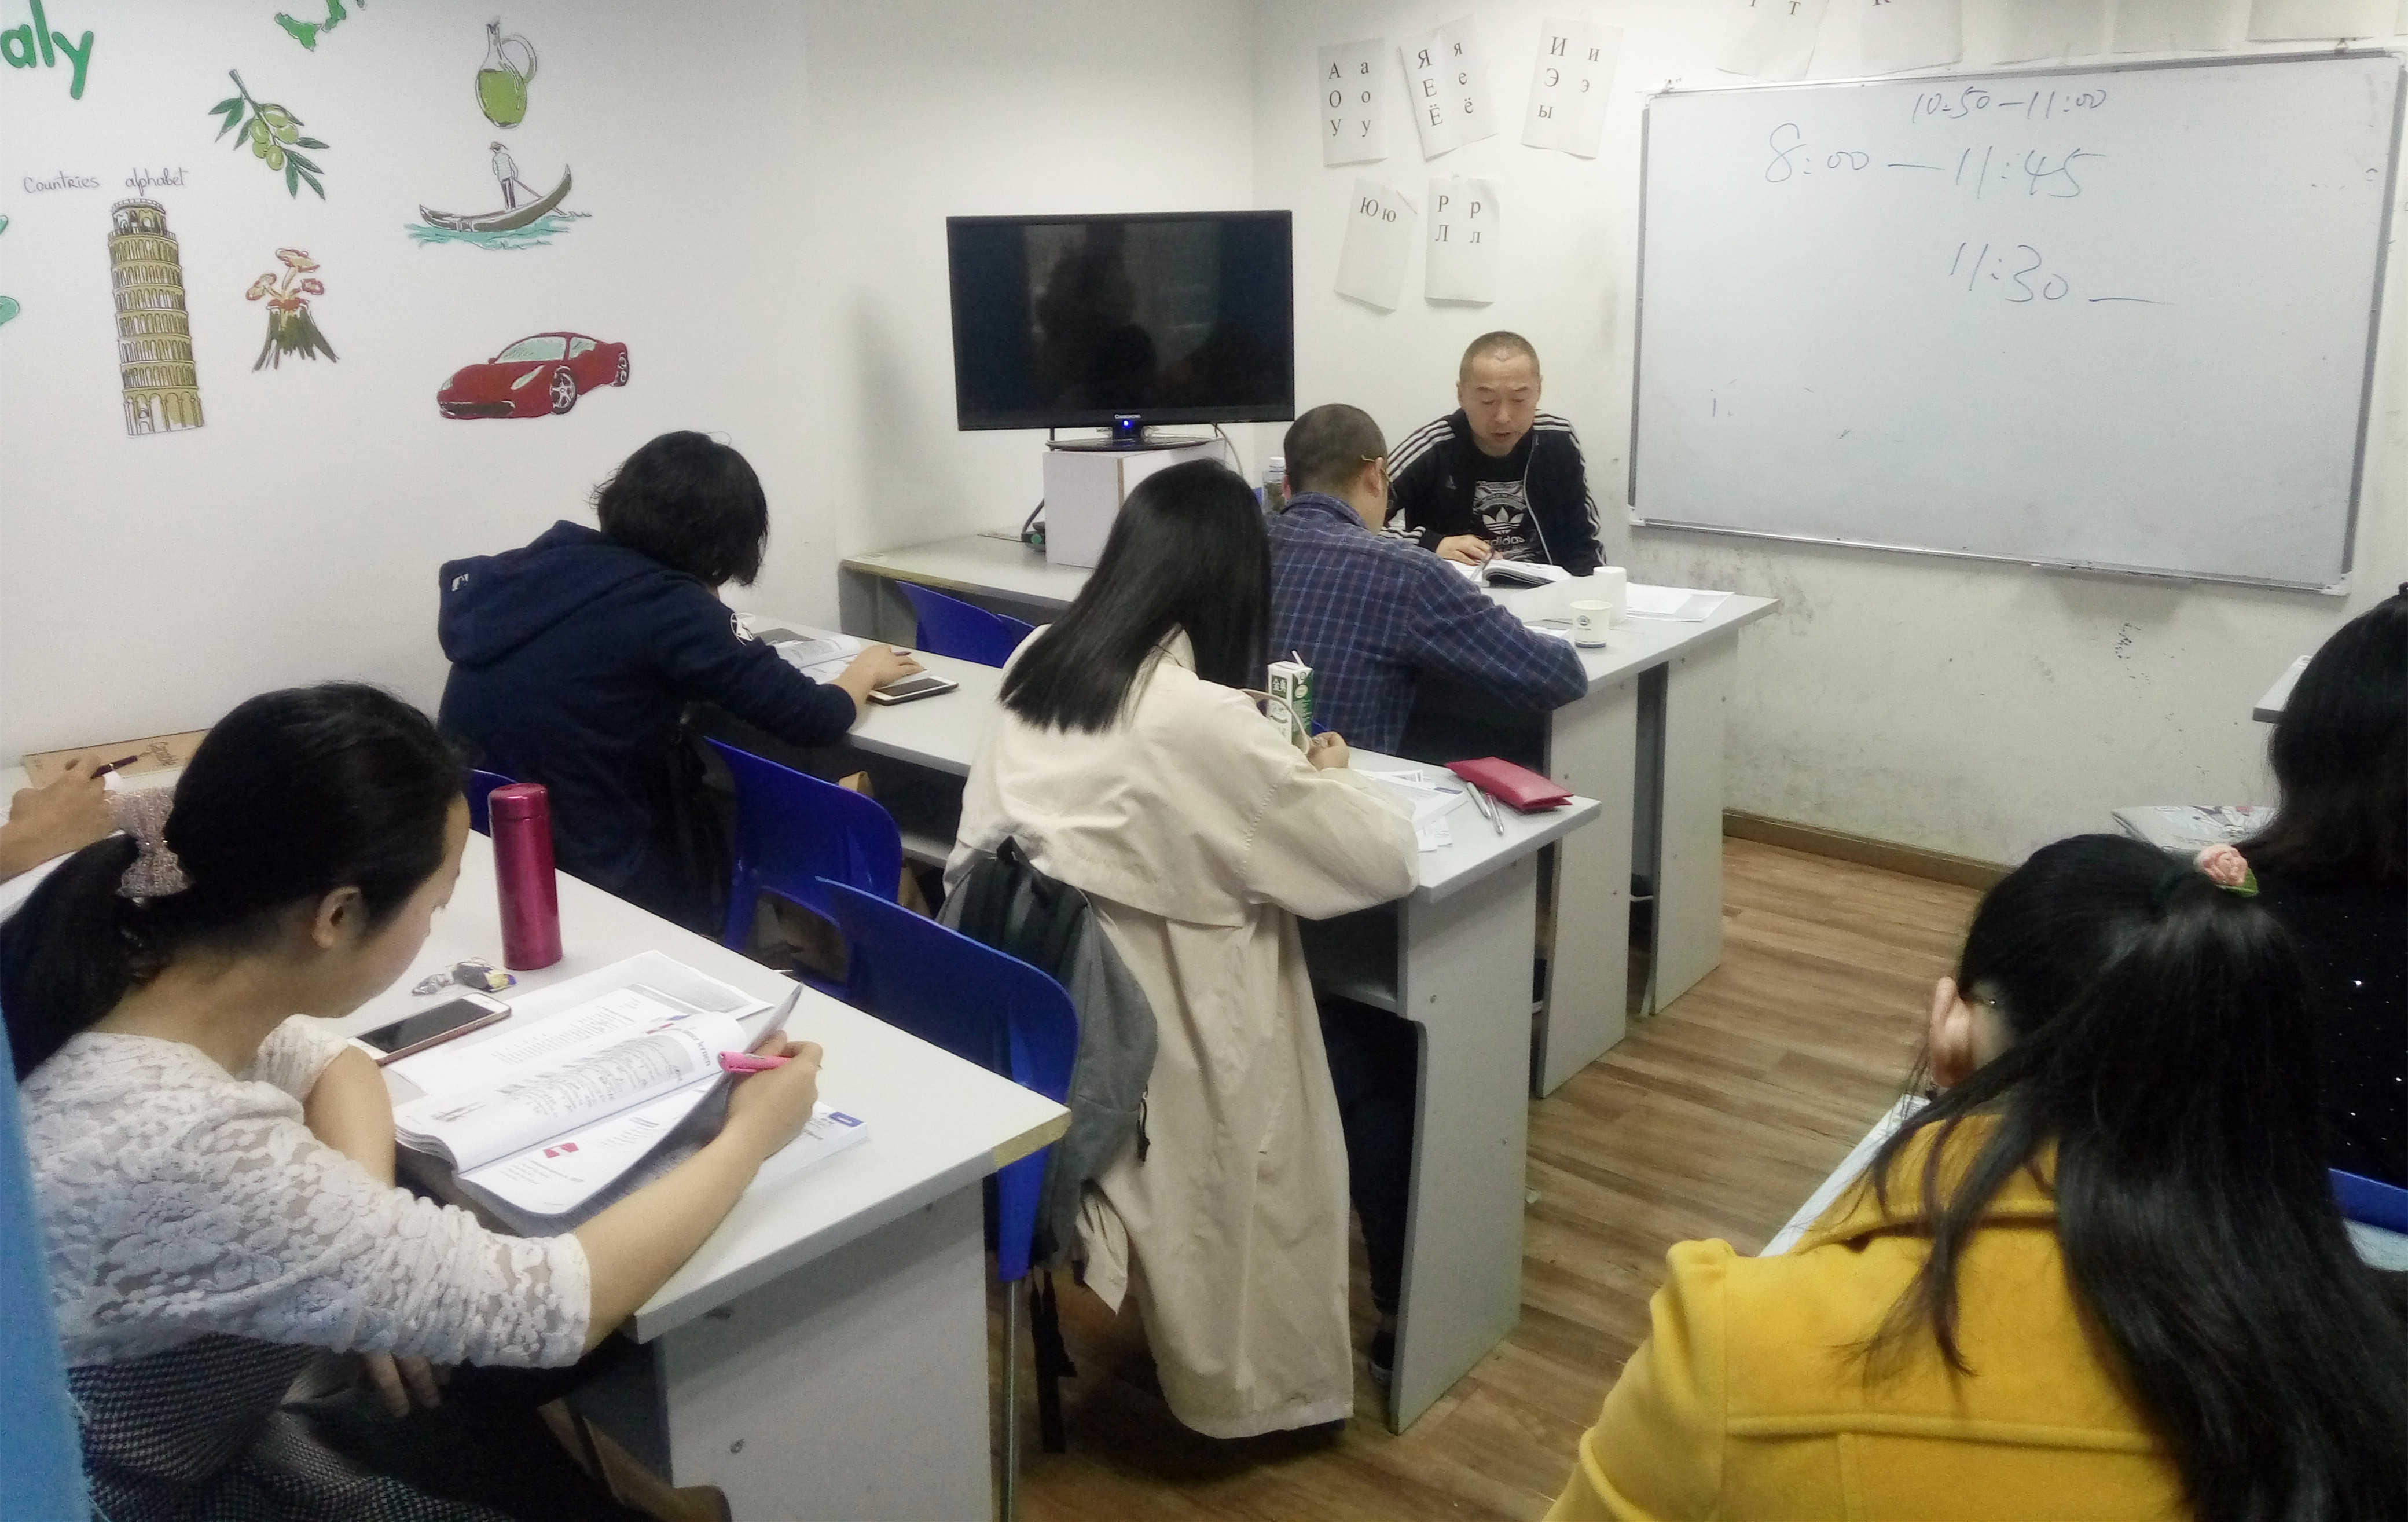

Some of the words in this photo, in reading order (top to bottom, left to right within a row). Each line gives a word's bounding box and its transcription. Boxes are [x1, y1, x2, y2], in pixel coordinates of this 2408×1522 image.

[1418, 49, 1432, 69] Я
[1453, 42, 1463, 57] я
[1550, 36, 1568, 57] И
[1587, 47, 1600, 62] и
[1328, 61, 1342, 80] А
[1360, 61, 1370, 75] а
[1544, 68, 1560, 87] Э
[1581, 79, 1590, 93] э
[1422, 78, 1437, 98] Е
[1458, 72, 1468, 85] е
[1428, 104, 1443, 126] Ё
[1464, 97, 1474, 114] ё
[125, 167, 188, 197] alphabet
[1437, 195, 1449, 213] Р
[1469, 201, 1481, 219] р
[1434, 224, 1449, 243] Л
[1469, 231, 1481, 244] л
[1484, 535, 1525, 545] didas
